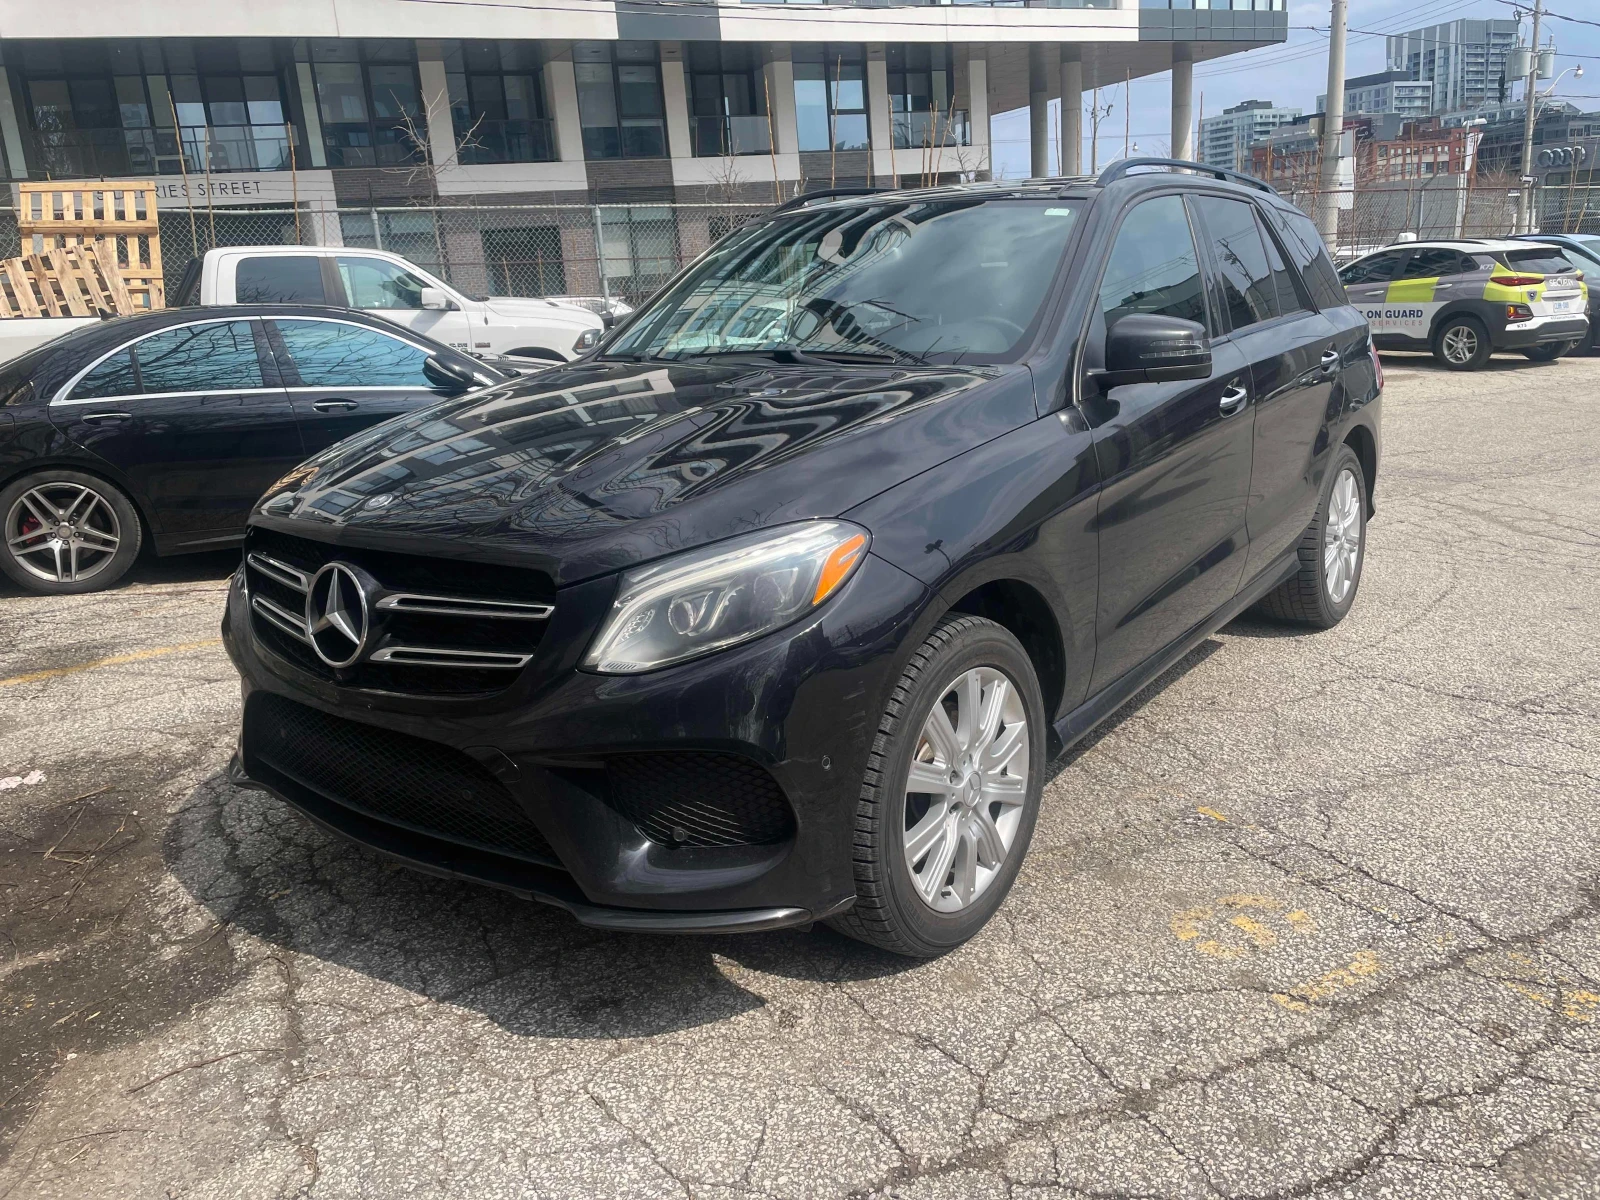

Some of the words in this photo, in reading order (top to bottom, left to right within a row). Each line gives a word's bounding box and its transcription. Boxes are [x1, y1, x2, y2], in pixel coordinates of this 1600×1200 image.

[198, 181, 261, 196] STREET
[1366, 310, 1382, 319] ON
[1385, 309, 1423, 318] GUARD
